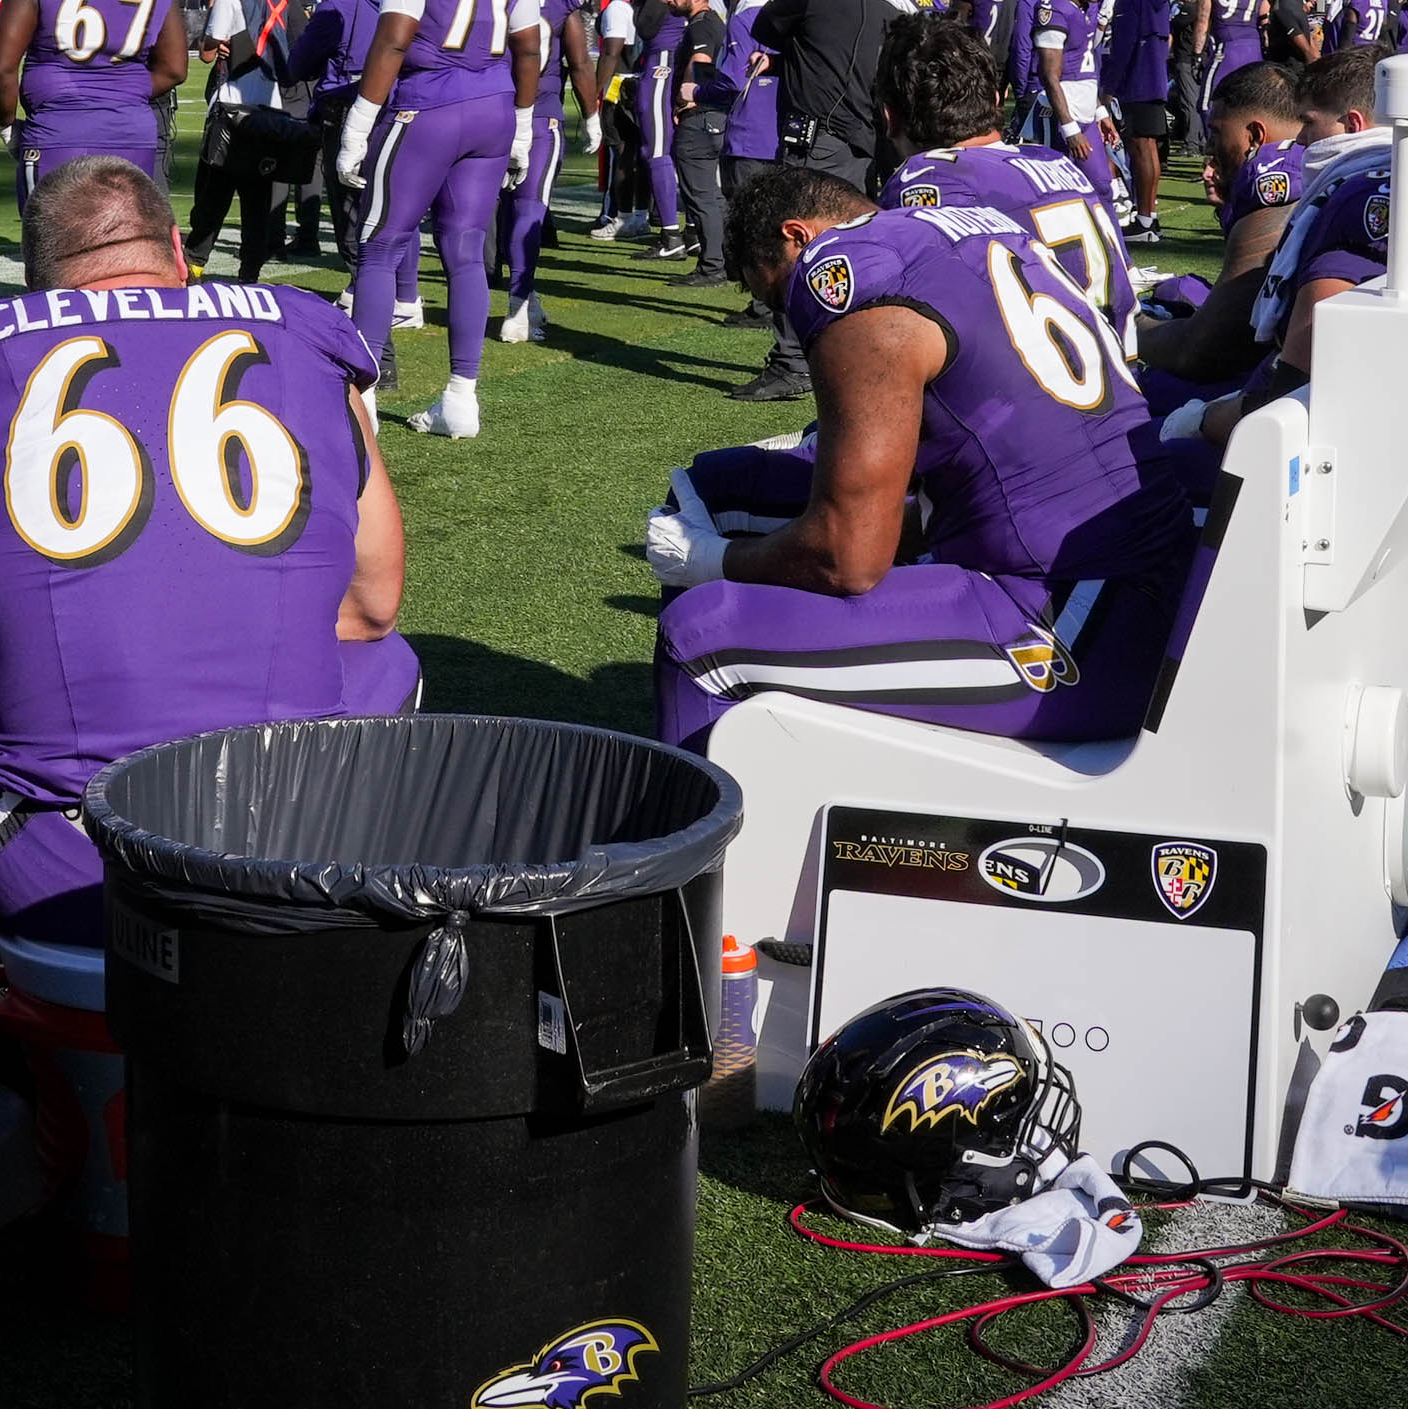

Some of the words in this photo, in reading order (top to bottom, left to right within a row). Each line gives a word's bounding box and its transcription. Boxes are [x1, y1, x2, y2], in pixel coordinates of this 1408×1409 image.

[1359, 8, 1385, 41] 21
[811, 259, 844, 278] RAVENS
[3, 329, 311, 566] 66
[833, 840, 969, 872] RAVENS
[861, 834, 945, 849] BALTIMORE
[1158, 847, 1210, 861] RAVENS
[114, 910, 175, 974] ULINE
